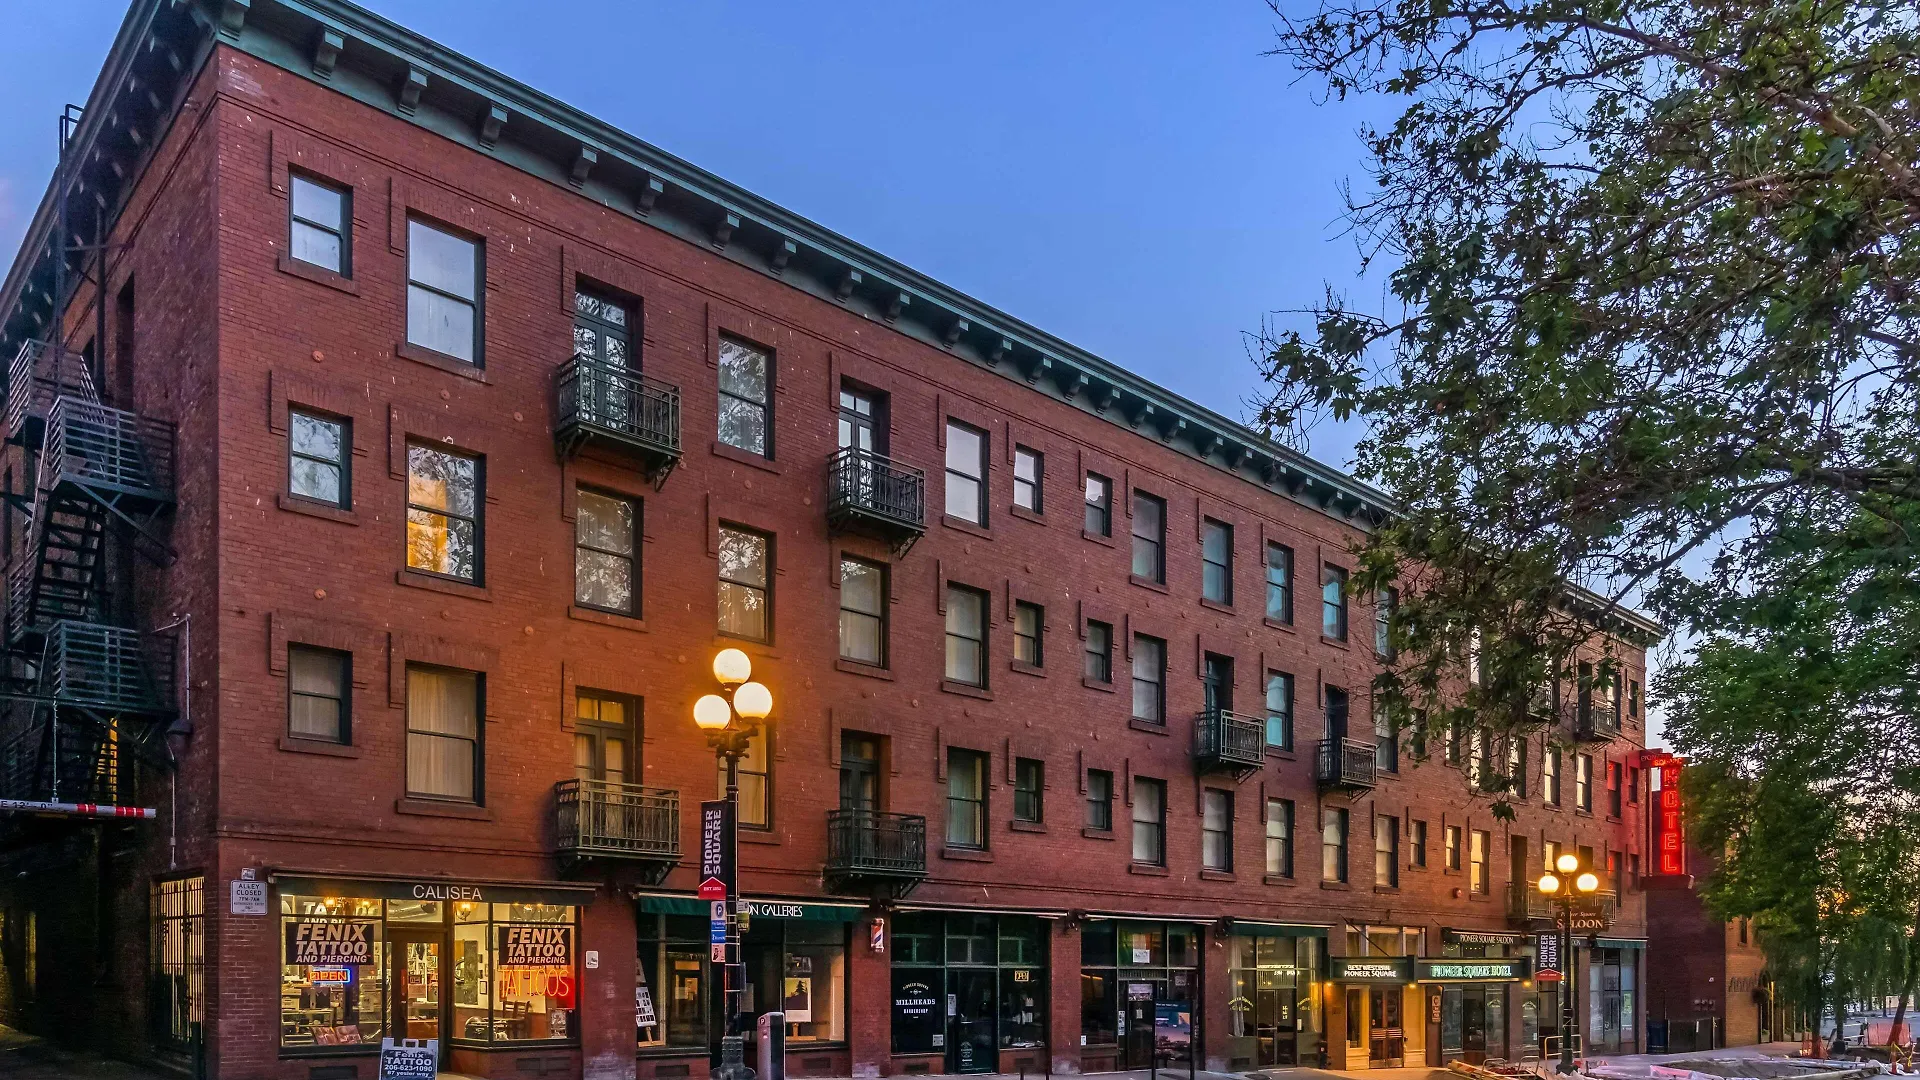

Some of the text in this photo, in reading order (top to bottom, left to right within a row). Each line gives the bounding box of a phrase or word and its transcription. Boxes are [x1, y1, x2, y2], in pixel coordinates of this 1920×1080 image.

[1664, 769, 1677, 871] HOTEL
[704, 810, 713, 875] PIONEER
[713, 809, 722, 875] SQUARE
[413, 884, 483, 901] CALISEA
[761, 904, 803, 917] GALLERIES
[1557, 919, 1604, 929] SLOON
[296, 923, 368, 941] FENIX
[507, 928, 566, 944] FENIX
[1460, 934, 1514, 944] PIONEER SQUARE SALOON
[295, 941, 368, 956] TATTOO
[507, 943, 566, 957] TATTOO
[1540, 934, 1549, 968] PIONEER
[1548, 934, 1557, 968] SQUARE
[295, 955, 367, 963] AND PIERCING
[507, 956, 566, 964] AND PIERCING
[310, 971, 347, 981] OPEN
[1371, 970, 1397, 978] SQUARE
[1431, 965, 1512, 978] PIONEER SQUARE HOTEL
[498, 969, 570, 997] TATTOOS
[385, 1057, 432, 1066] TATTOO
